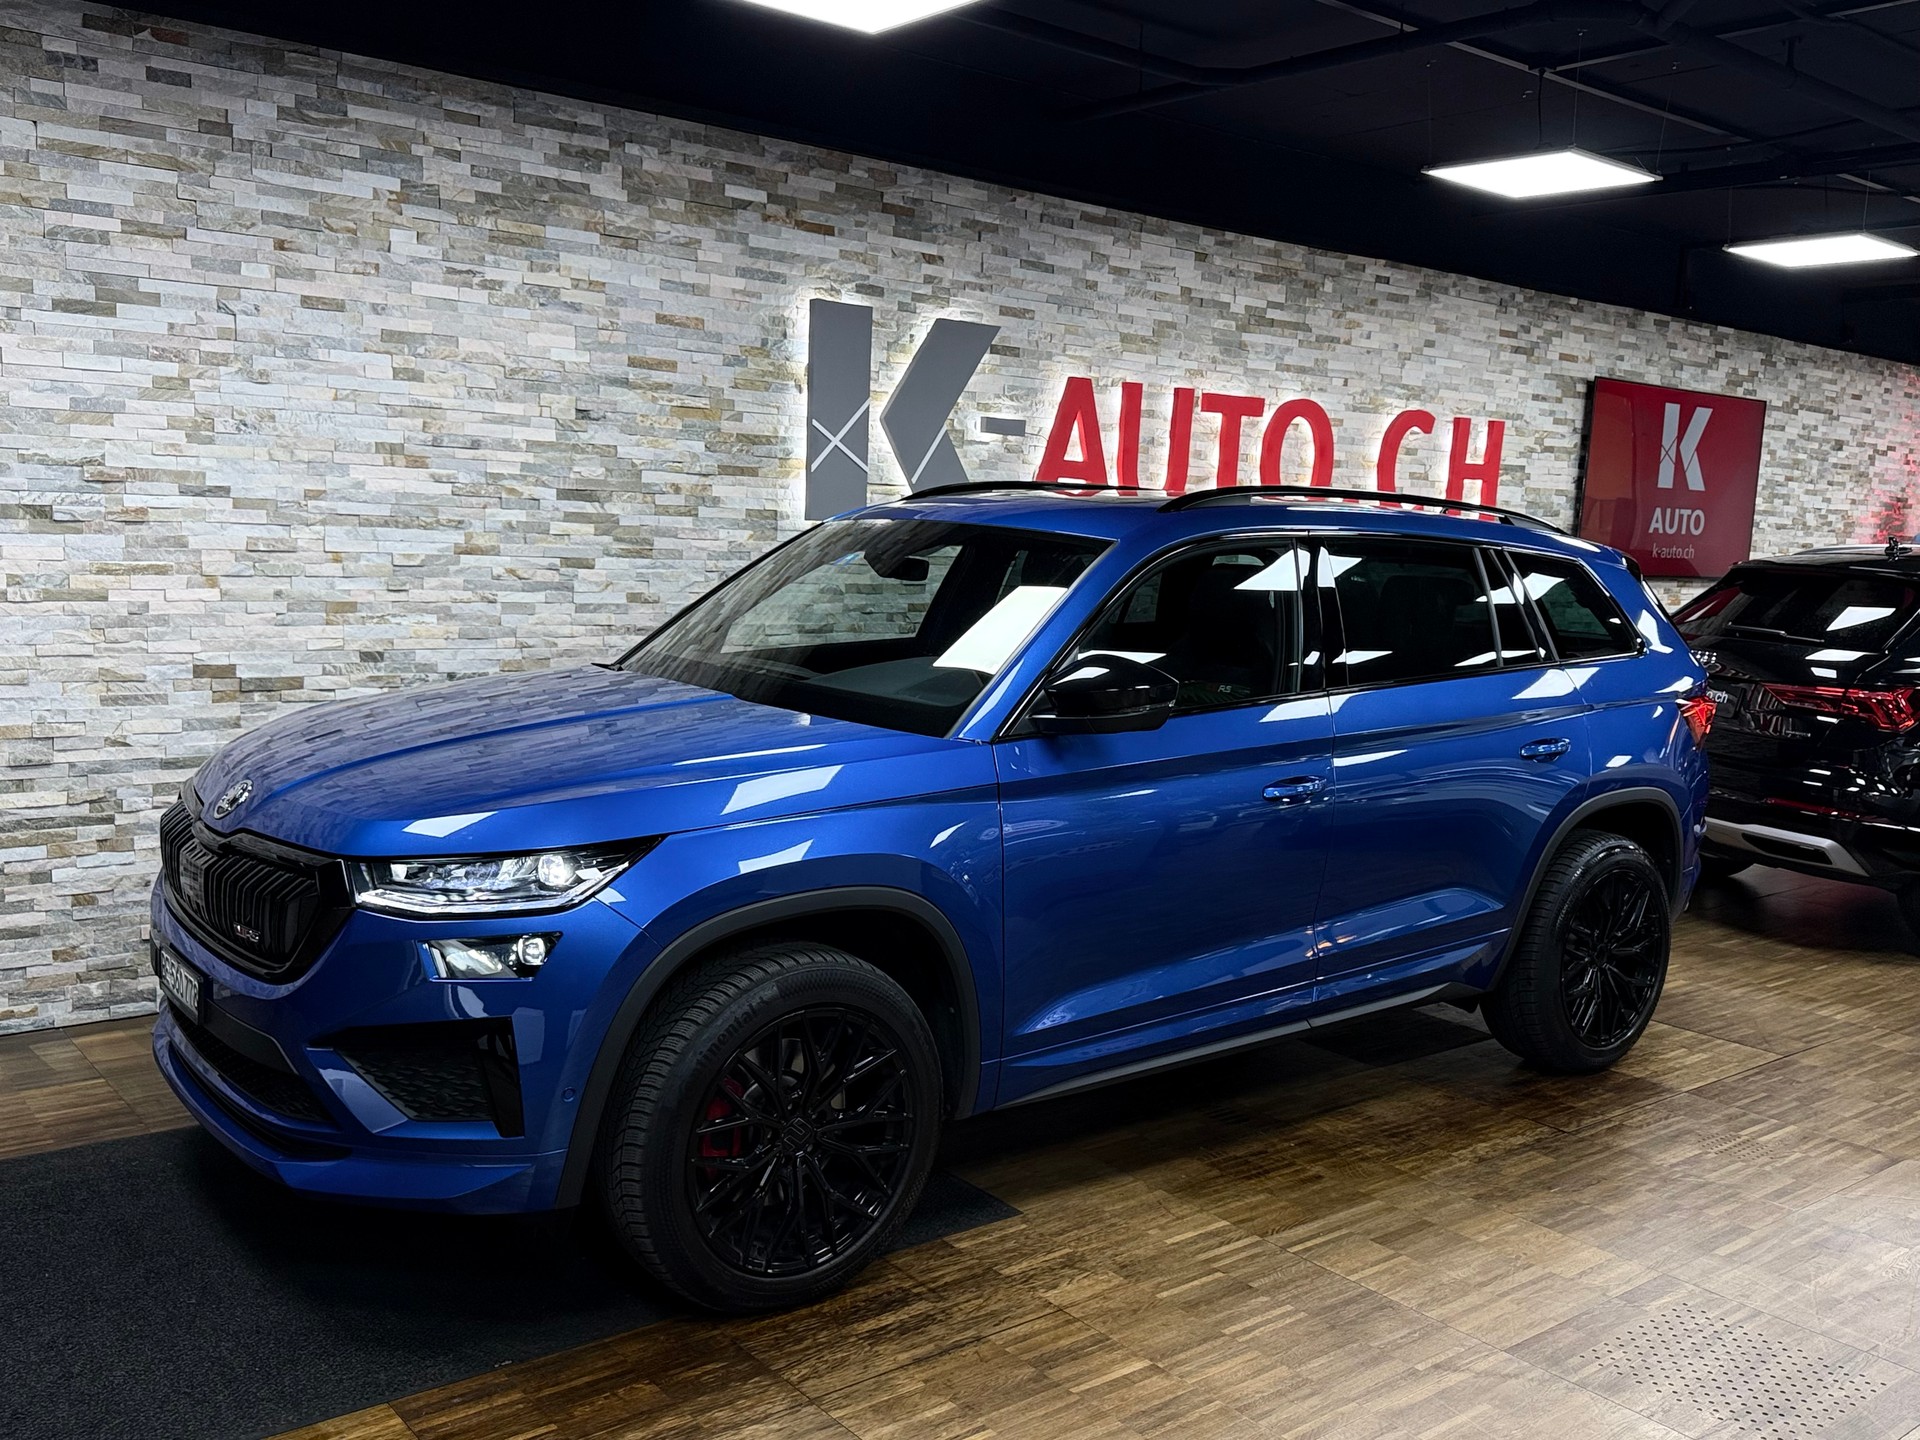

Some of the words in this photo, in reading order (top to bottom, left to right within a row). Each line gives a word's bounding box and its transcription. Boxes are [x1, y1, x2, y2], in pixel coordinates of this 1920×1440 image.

[805, 298, 1506, 521] K-AUTOCH
[1657, 402, 1713, 491] K
[1648, 507, 1705, 536] AUTO
[1652, 543, 1695, 559] k-auto.ch
